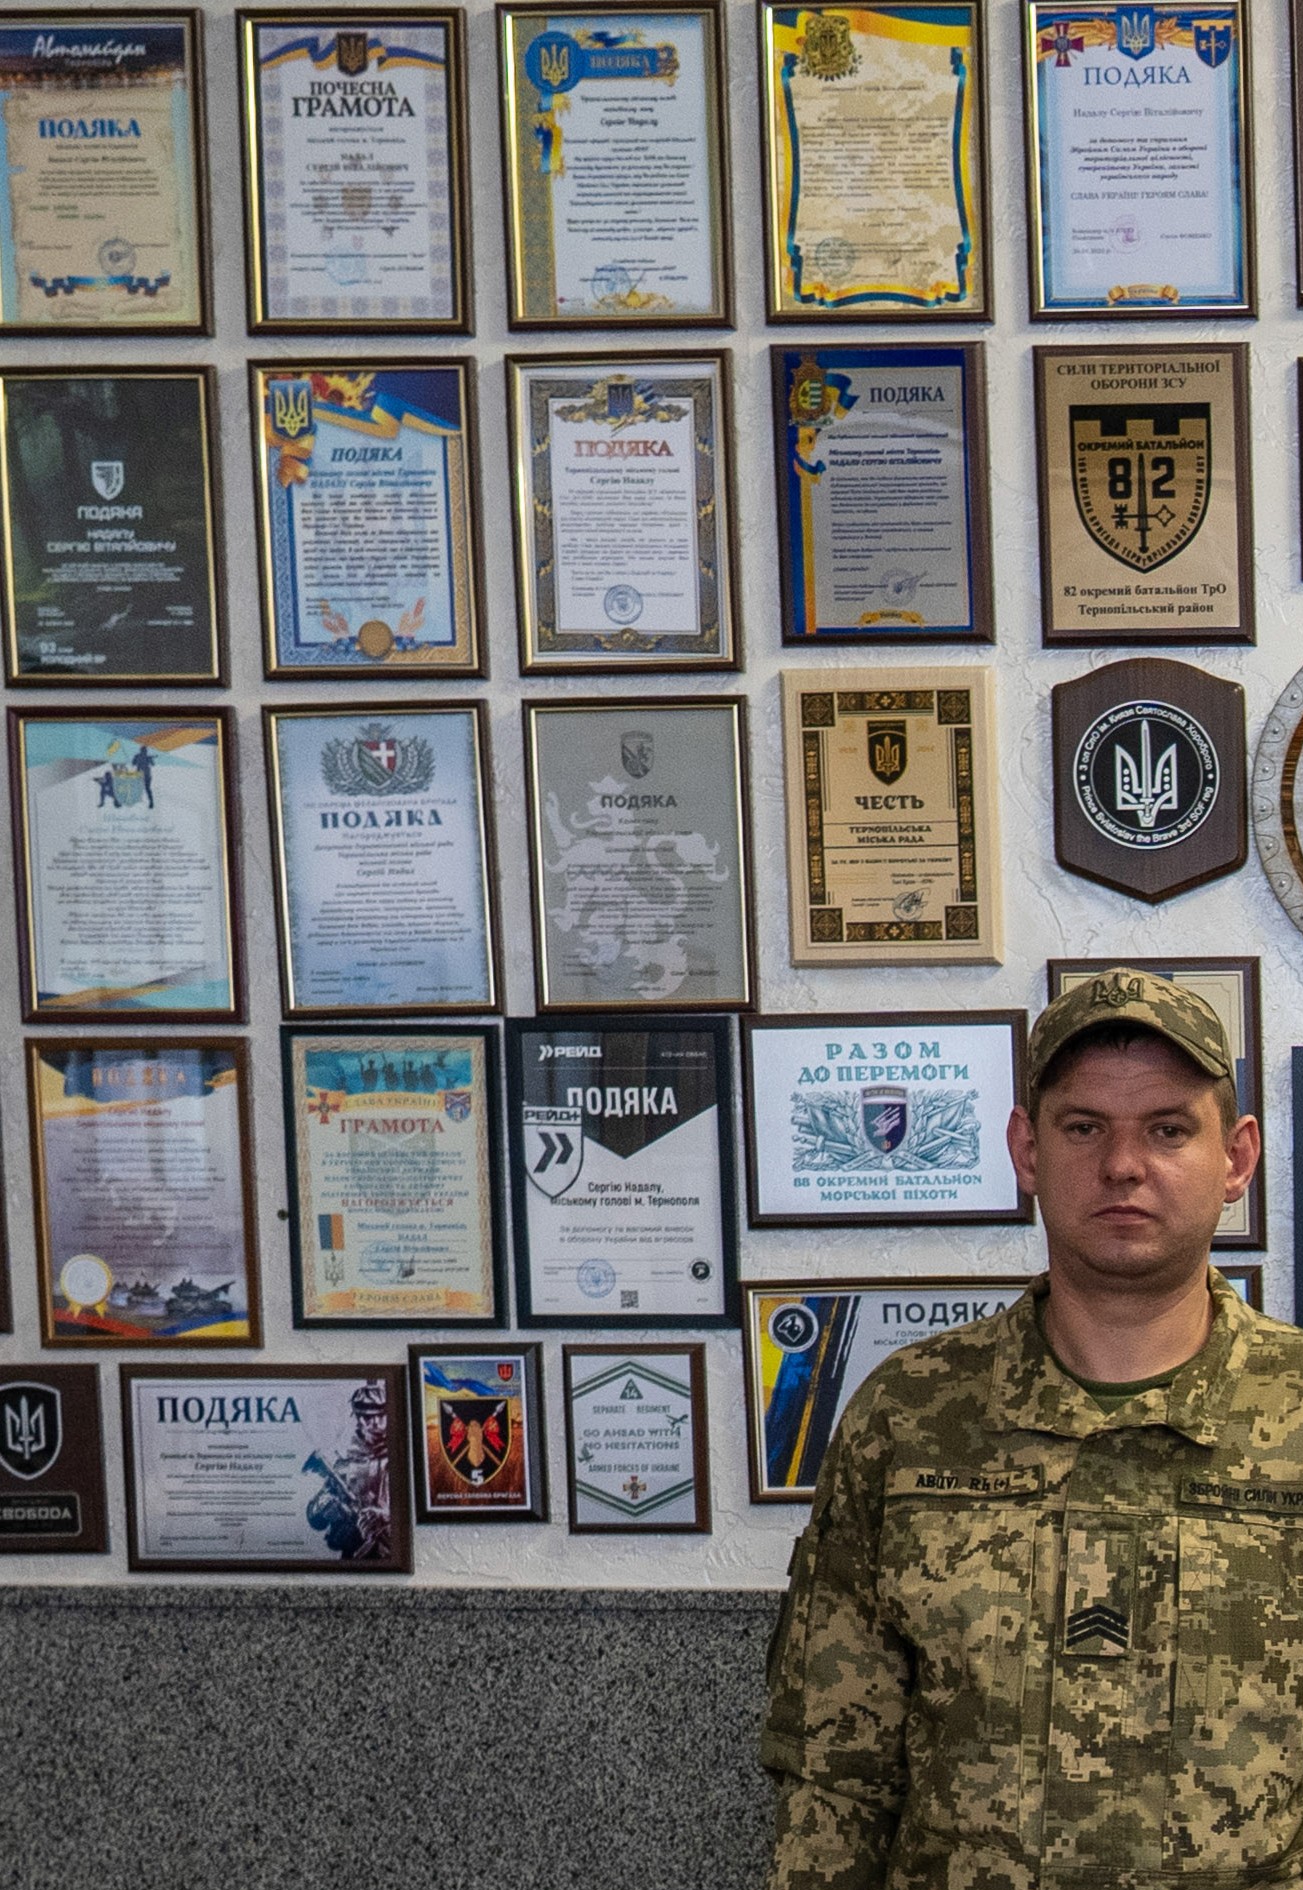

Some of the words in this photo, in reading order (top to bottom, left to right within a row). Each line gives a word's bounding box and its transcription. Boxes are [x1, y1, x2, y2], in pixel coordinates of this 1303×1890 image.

[1083, 65, 1192, 88] ПОДЯКА
[310, 82, 396, 97] ПОЧЕСНА
[292, 98, 416, 118] ГРАМОТА
[39, 118, 141, 140] ПОДЯКА
[1058, 364, 1096, 376] СИЛИ
[1100, 359, 1221, 375] ТЕРИТОРІАЛЬНОЇ
[1091, 376, 1157, 392] ОБОРОНИ
[1162, 375, 1188, 390] ЗСУ
[869, 386, 945, 404] ПОДЯКА
[574, 440, 672, 458] ПОДЯКА
[1078, 438, 1133, 452] ОКРЕМИЙ
[1136, 437, 1205, 451] БАТАЛЬЙОН
[331, 447, 403, 463] ПОДЯКА
[1063, 585, 1076, 597] 82
[1080, 585, 1131, 600] окремий
[1135, 583, 1198, 597] батальйон
[1201, 583, 1227, 598] ТрО
[1077, 601, 1174, 616] Тернопільський
[1176, 602, 1214, 616] район
[601, 794, 677, 810] ПОДЯКА
[854, 795, 925, 811] ЧЕСТЬ
[320, 812, 443, 829] ПОДЯКА
[825, 1041, 941, 1060] РАЗОМ
[798, 1066, 830, 1085] ДО
[839, 1063, 970, 1082] ПЕРЕМОГИ
[567, 1086, 678, 1117] ПОДЯКА
[340, 1118, 446, 1134] ГРАМОТА
[793, 1176, 811, 1188] 88
[816, 1176, 889, 1187] ОКРЕМИЙ
[897, 1174, 982, 1186] БАТАЛЬЙОН
[820, 1188, 897, 1202] МОРСЬКОЇ
[903, 1188, 958, 1200] ПІХОТИ
[158, 1397, 301, 1428] ПОДЯКА
[583, 1428, 598, 1438] GO
[602, 1427, 646, 1438] AHEAD
[605, 1440, 680, 1451] HESITATIONS
[1188, 1482, 1239, 1500] ЗБРОЙНІ
[1244, 1487, 1275, 1503] СИЛИ
